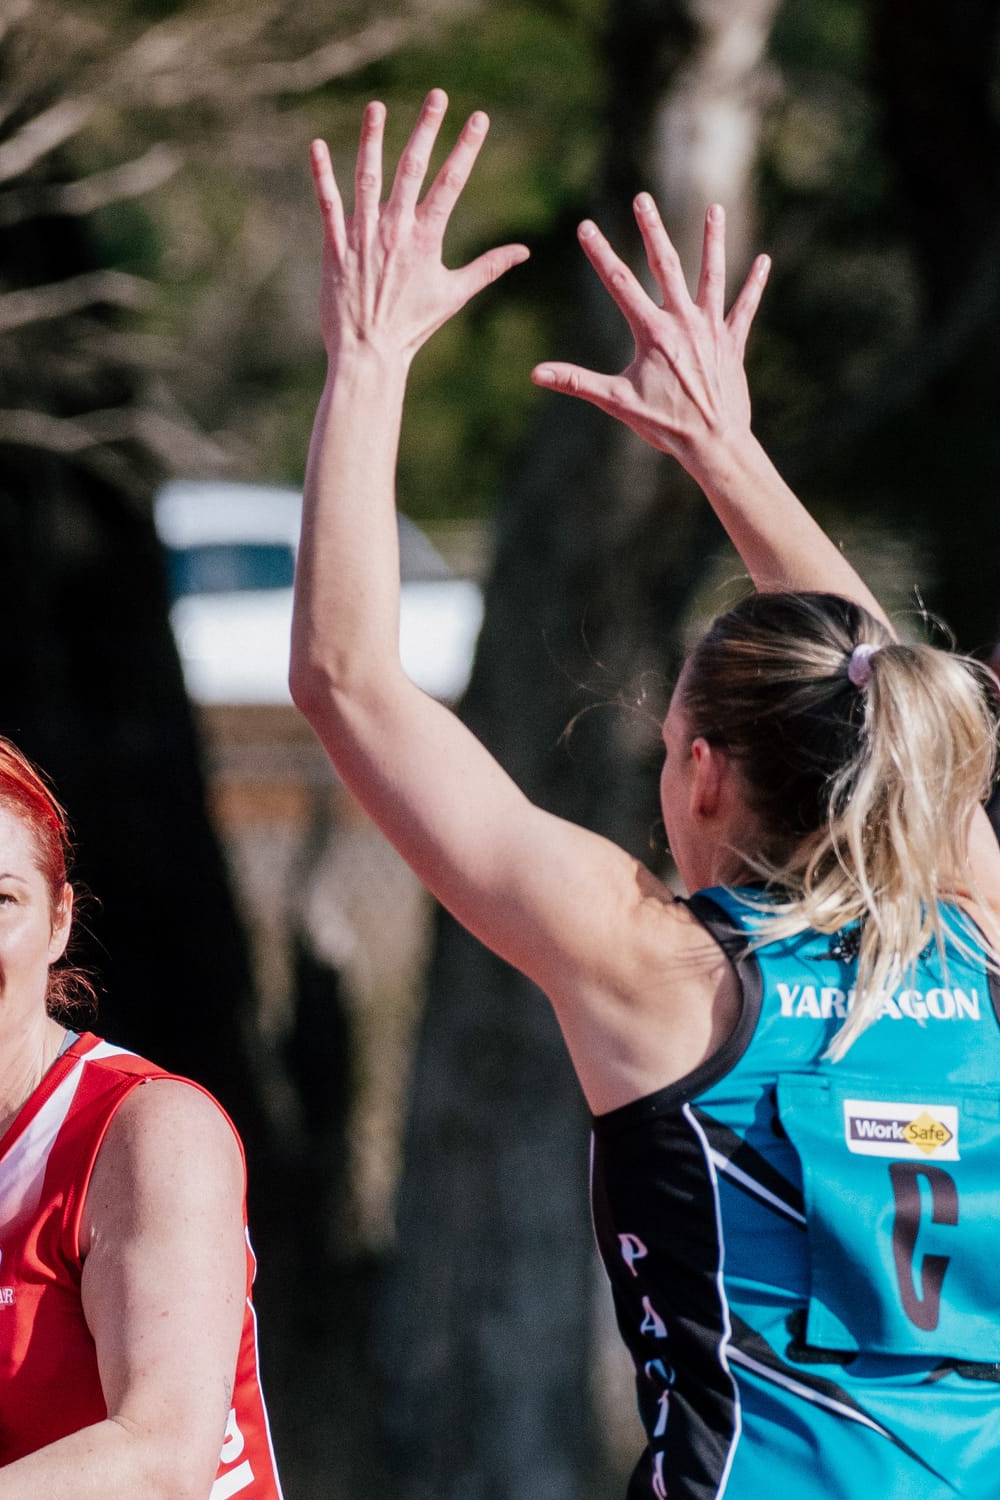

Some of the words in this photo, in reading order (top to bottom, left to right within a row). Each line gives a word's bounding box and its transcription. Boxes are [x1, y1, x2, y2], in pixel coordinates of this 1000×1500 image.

[776, 983, 980, 1021] YARAGON
[855, 1119, 945, 1142] WorkSafe
[889, 1162, 959, 1331] C
